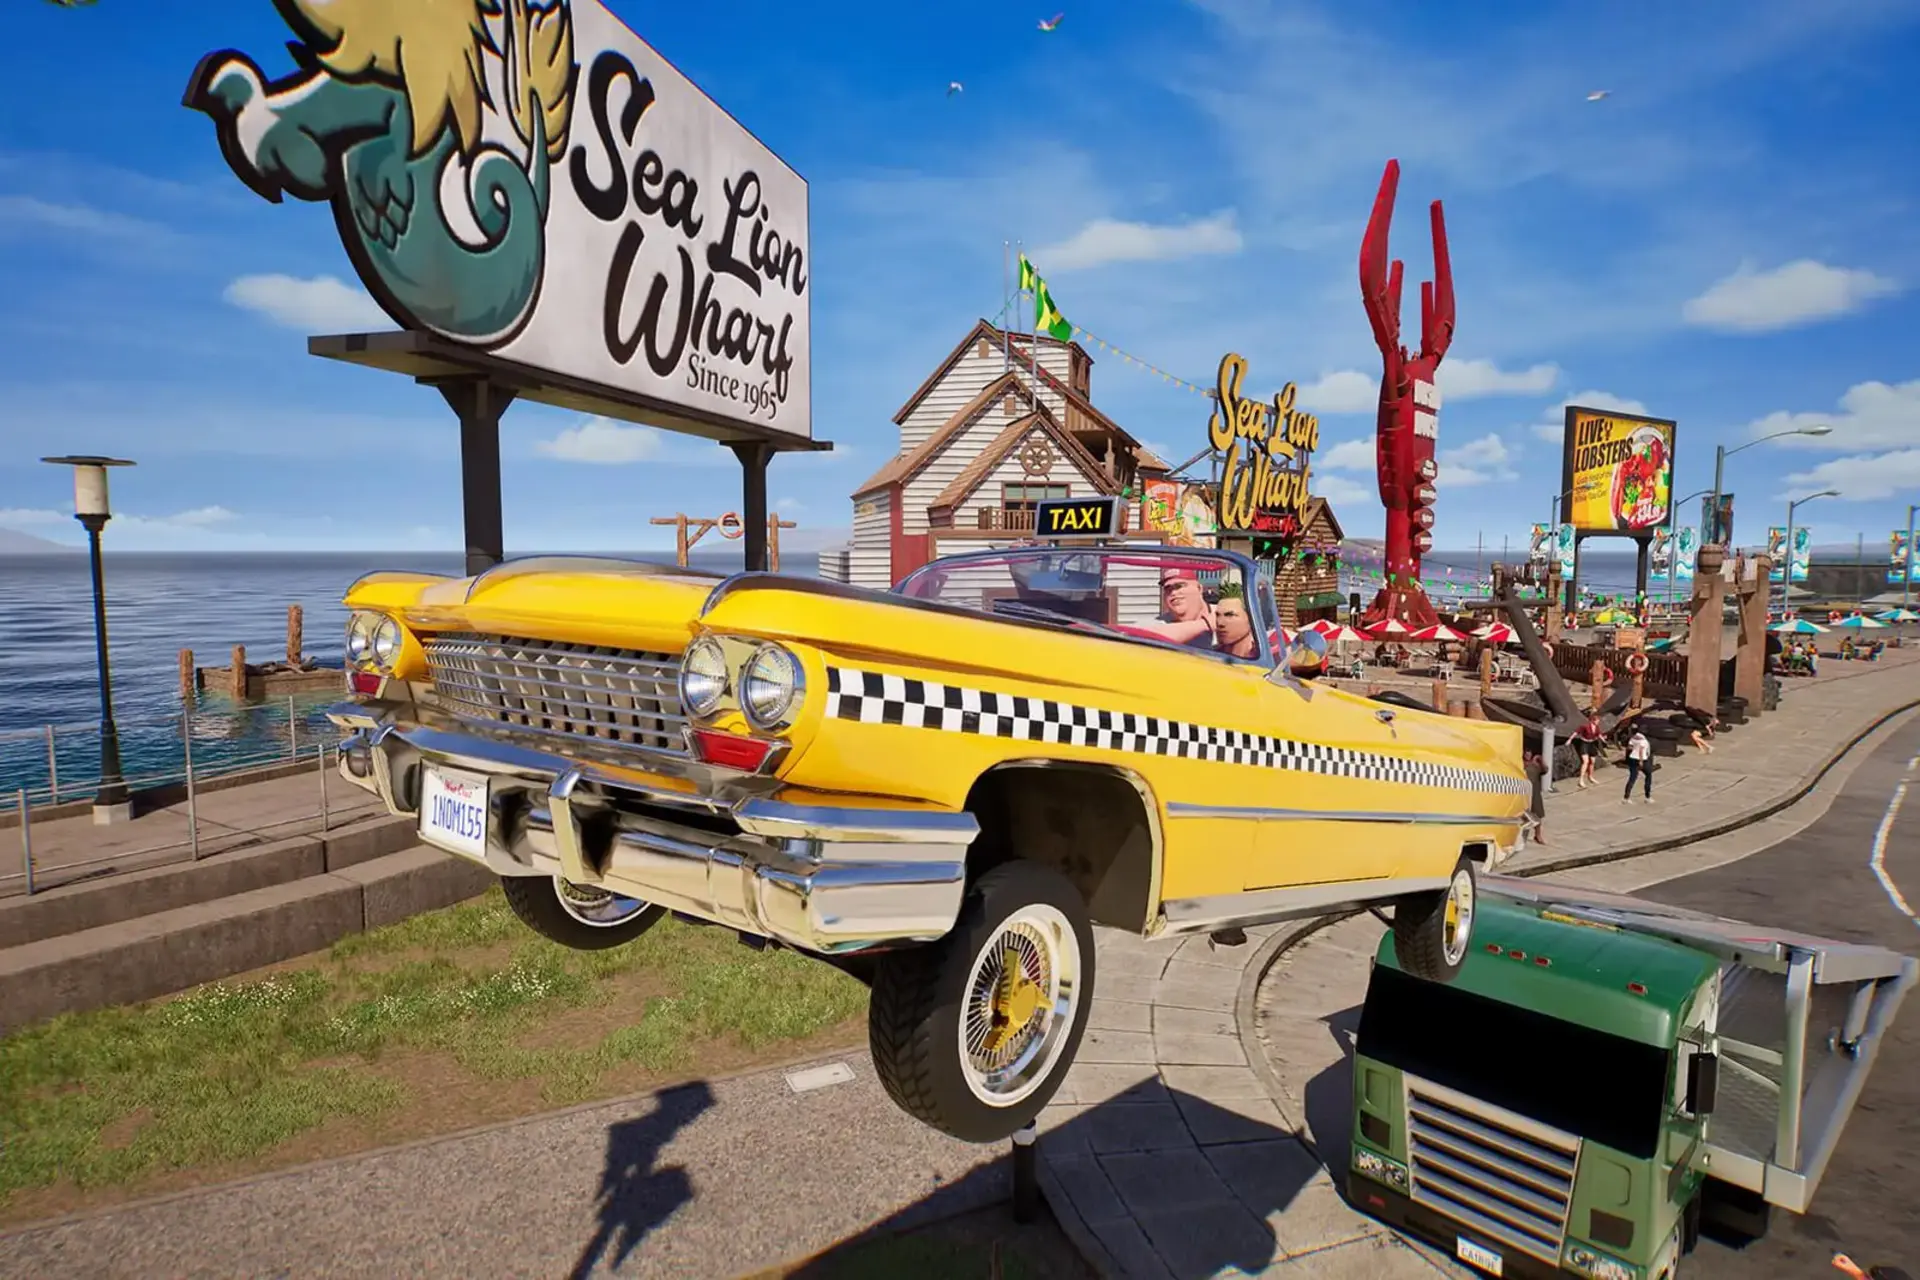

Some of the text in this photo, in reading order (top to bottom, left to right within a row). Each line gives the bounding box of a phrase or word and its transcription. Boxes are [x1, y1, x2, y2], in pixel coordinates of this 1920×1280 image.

[569, 50, 807, 297] Sea Lion
[603, 219, 794, 403] Wharf
[686, 353, 778, 420] Since 1965
[1208, 352, 1319, 460] Sea Lion
[1574, 437, 1634, 474] LOBSTERS
[1578, 418, 1605, 446] LIVE
[1049, 506, 1103, 530] TAXI
[1221, 443, 1312, 530] Wharf
[431, 794, 482, 840] 1NOM155
